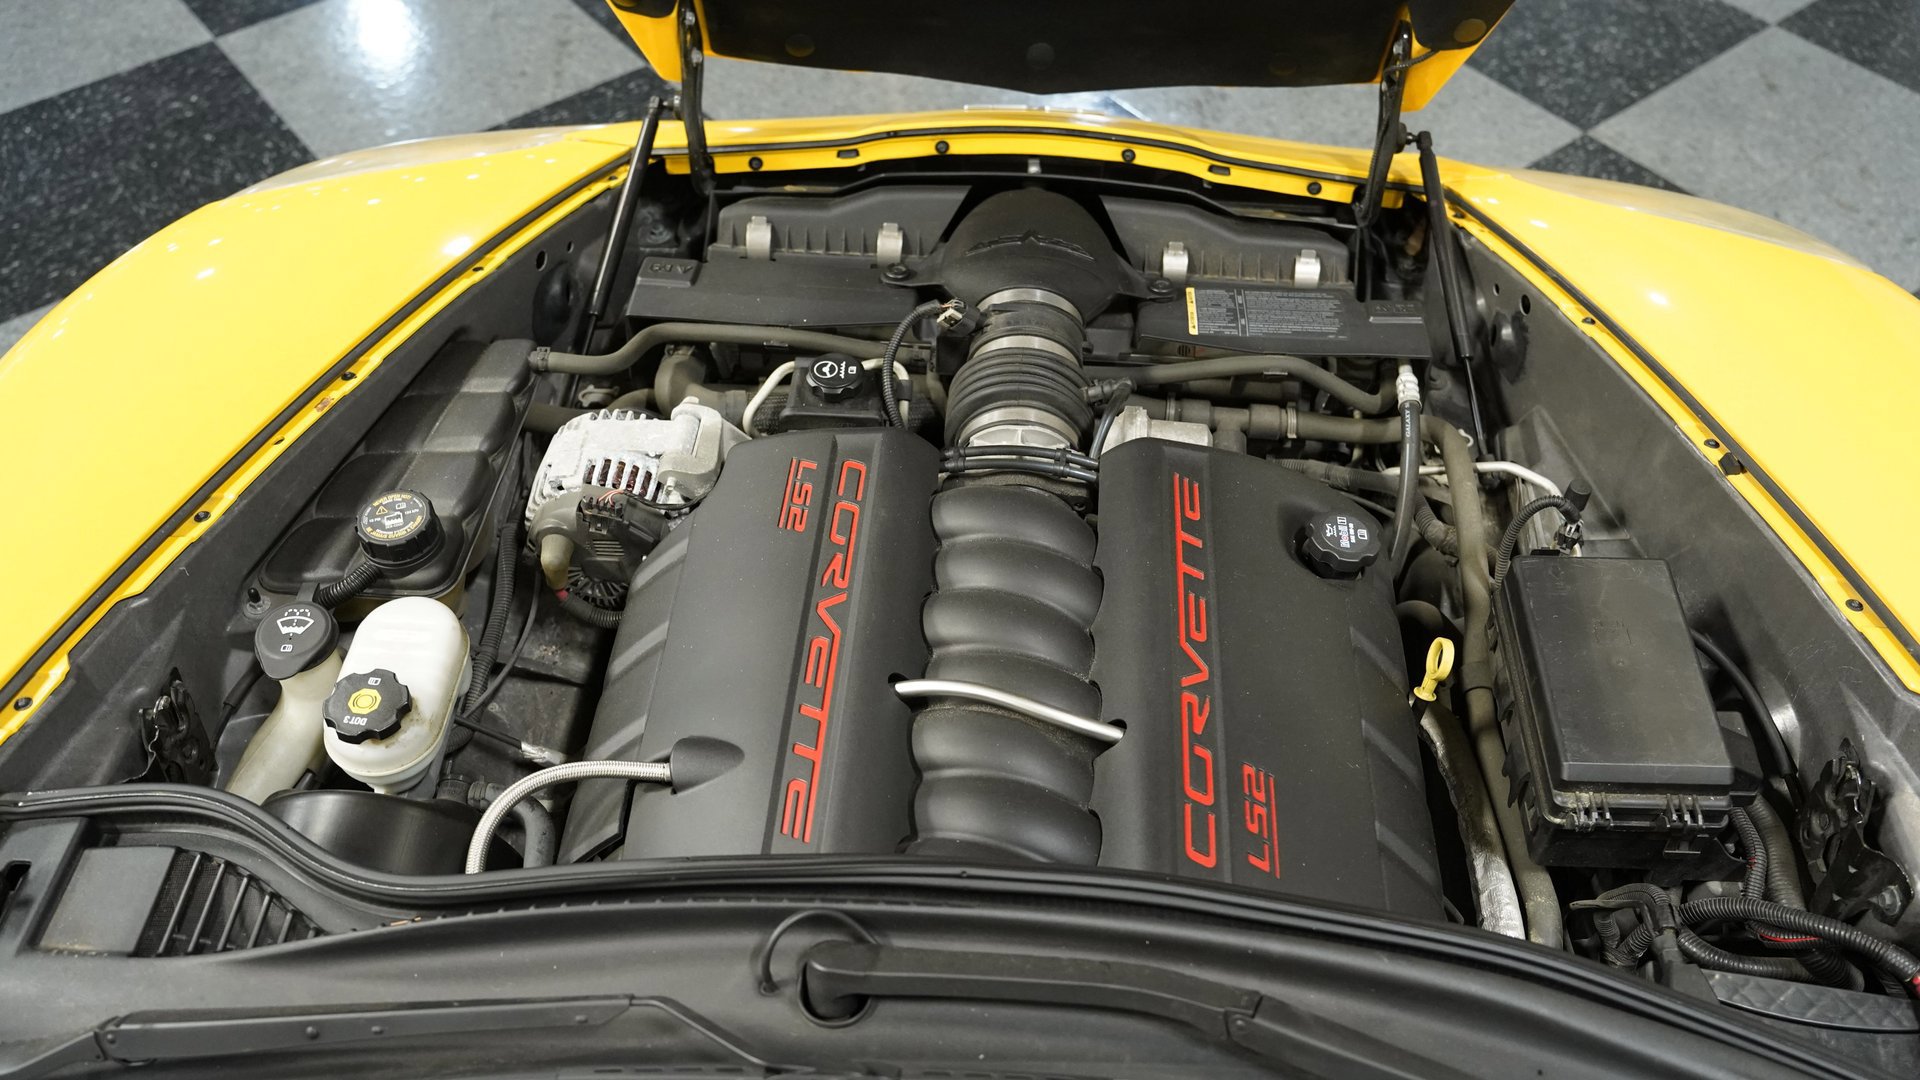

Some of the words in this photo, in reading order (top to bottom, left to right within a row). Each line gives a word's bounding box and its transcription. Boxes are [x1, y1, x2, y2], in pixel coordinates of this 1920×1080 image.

[786, 458, 818, 533] LS2
[781, 459, 867, 844] CORVETTE
[1173, 472, 1217, 869] CORVETTE
[343, 715, 350, 723] 3
[348, 716, 367, 725] DOT
[1242, 760, 1271, 873] LS2
